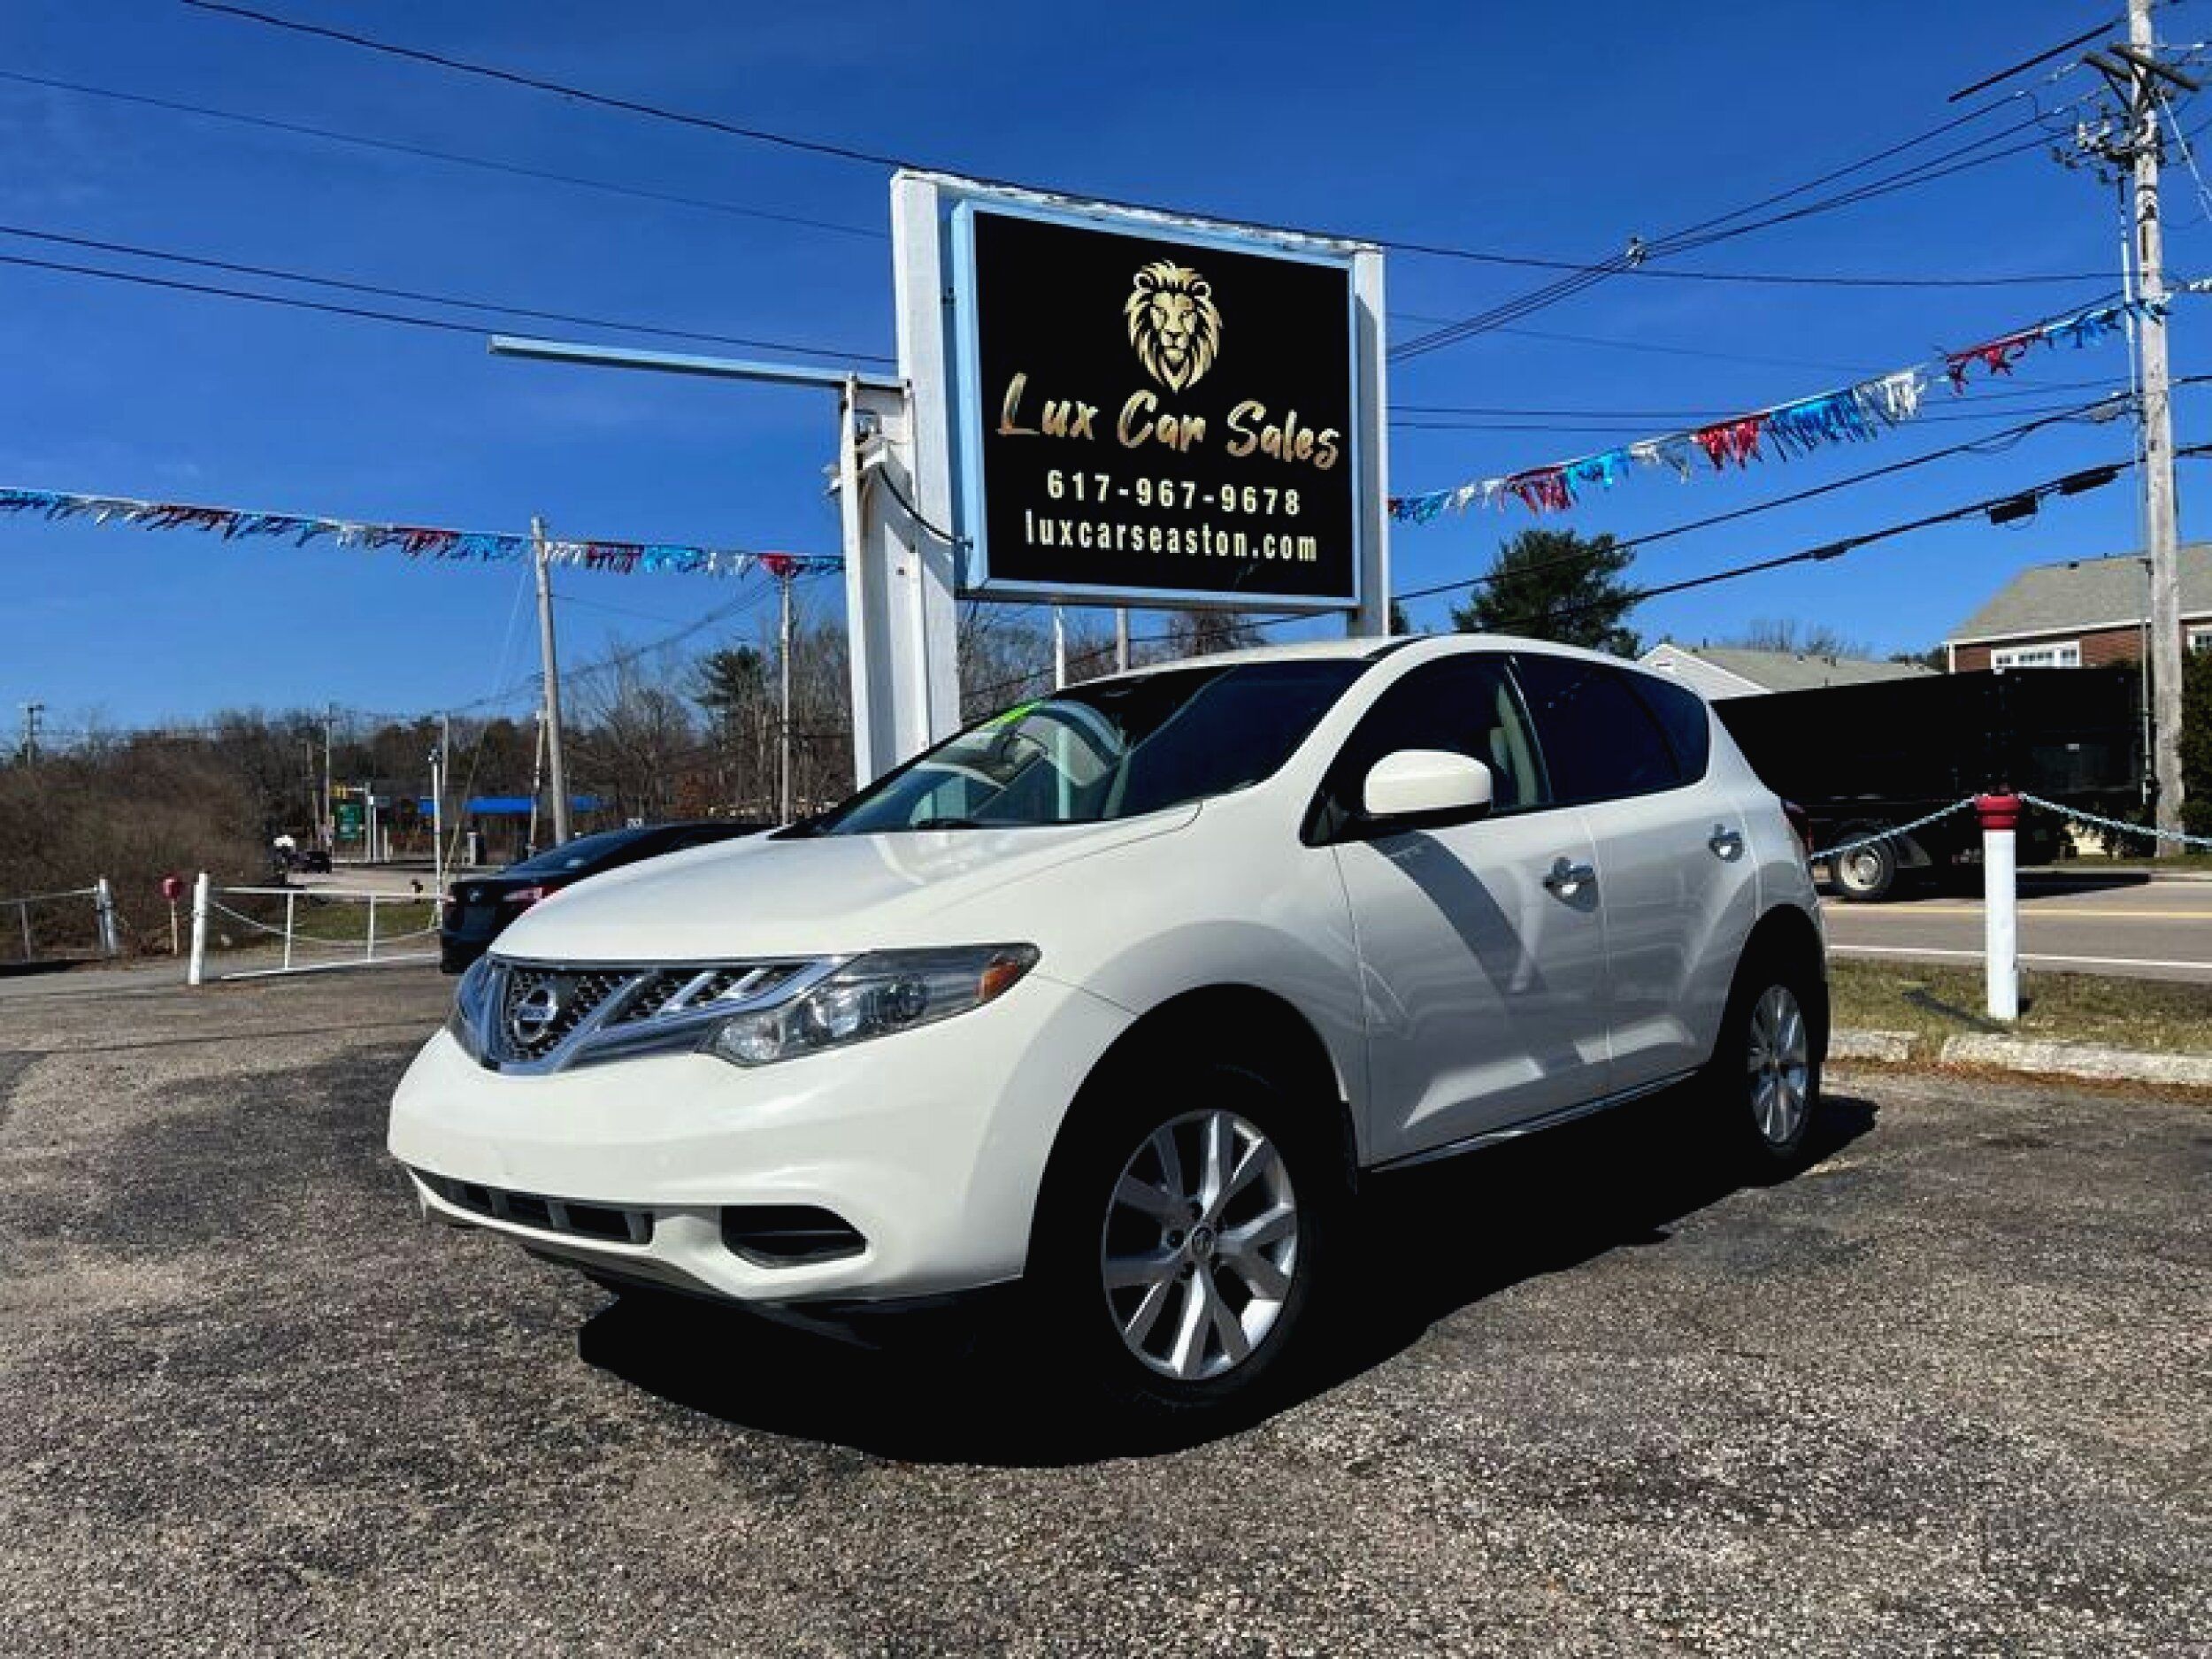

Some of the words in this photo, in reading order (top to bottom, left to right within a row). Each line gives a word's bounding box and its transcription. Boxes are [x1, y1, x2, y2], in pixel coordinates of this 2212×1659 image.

[997, 373, 1099, 441] Lux
[1117, 389, 1206, 452] Car
[1226, 400, 1341, 471] Sales
[1047, 469, 1301, 516] 617-967-9678
[1025, 508, 1317, 562] luxcarseaston.com
